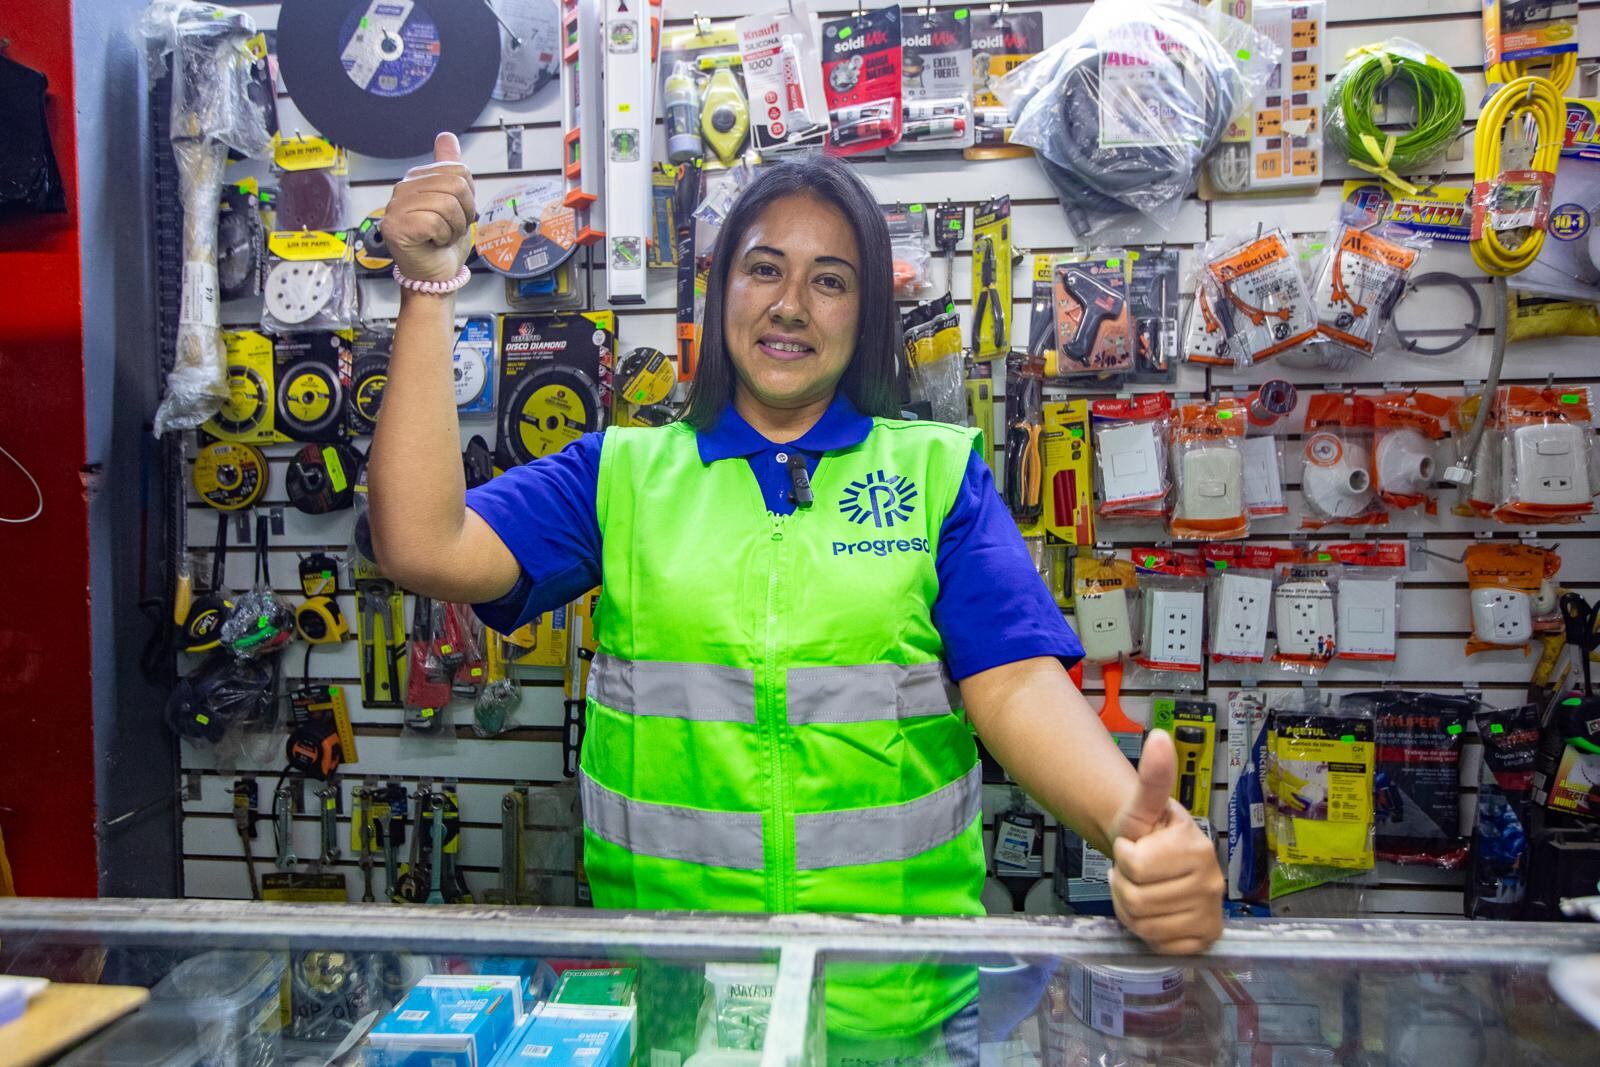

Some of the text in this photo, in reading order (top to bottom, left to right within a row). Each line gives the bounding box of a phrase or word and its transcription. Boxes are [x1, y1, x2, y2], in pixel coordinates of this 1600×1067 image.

[933, 56, 958, 68] EXTRA
[933, 67, 960, 78] FUERTE
[506, 341, 567, 351] DISCO DIAMOND
[1383, 716, 1440, 728] TRUPER
[1286, 727, 1326, 737] PRETUL
